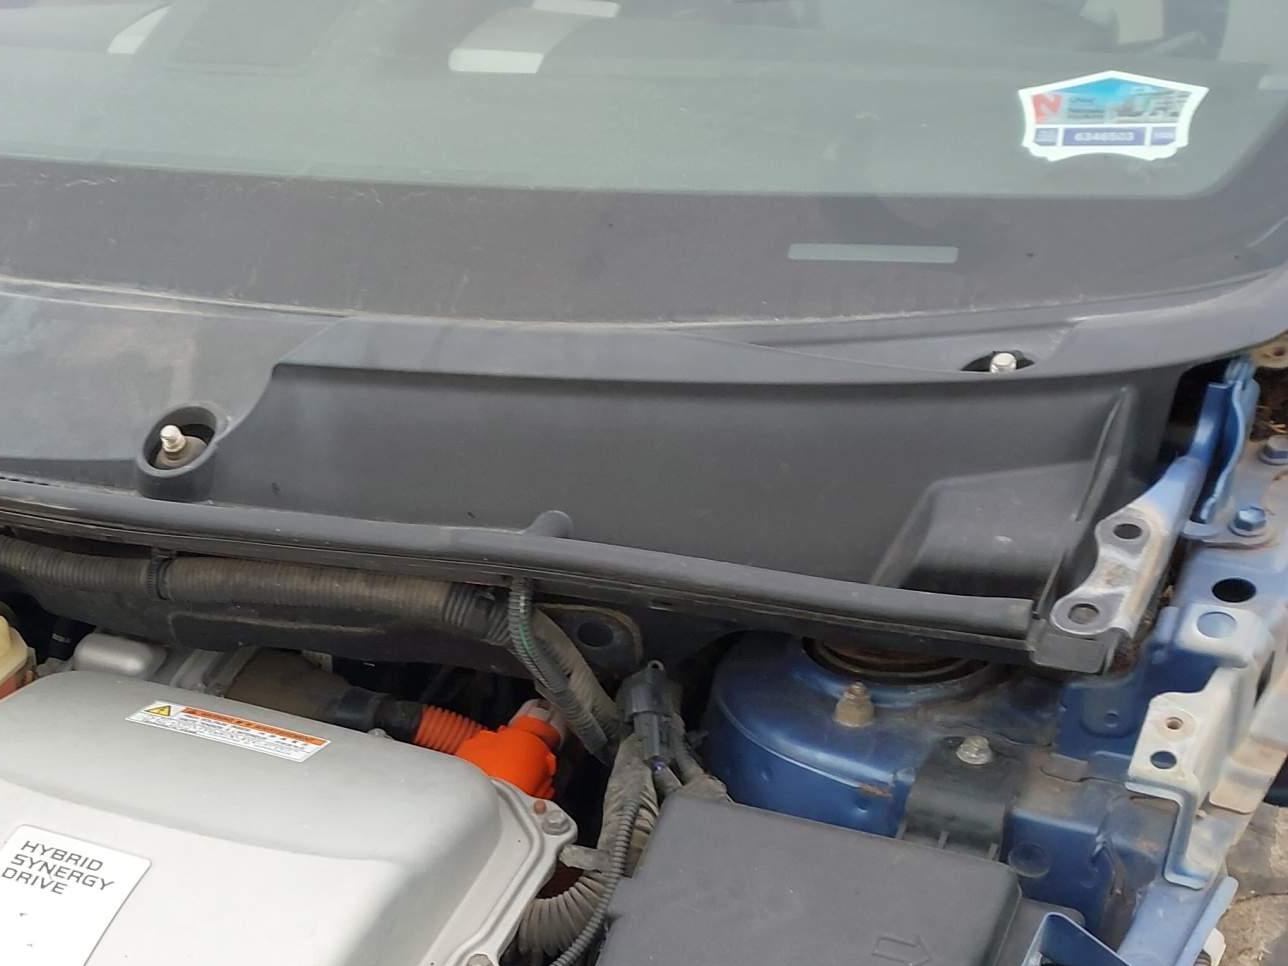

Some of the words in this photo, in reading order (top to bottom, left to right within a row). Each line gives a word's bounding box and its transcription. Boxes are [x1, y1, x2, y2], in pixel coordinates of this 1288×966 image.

[9, 853, 115, 891] SYNERGY
[20, 840, 104, 872] HYBRID
[1, 867, 69, 895] DRIVE
